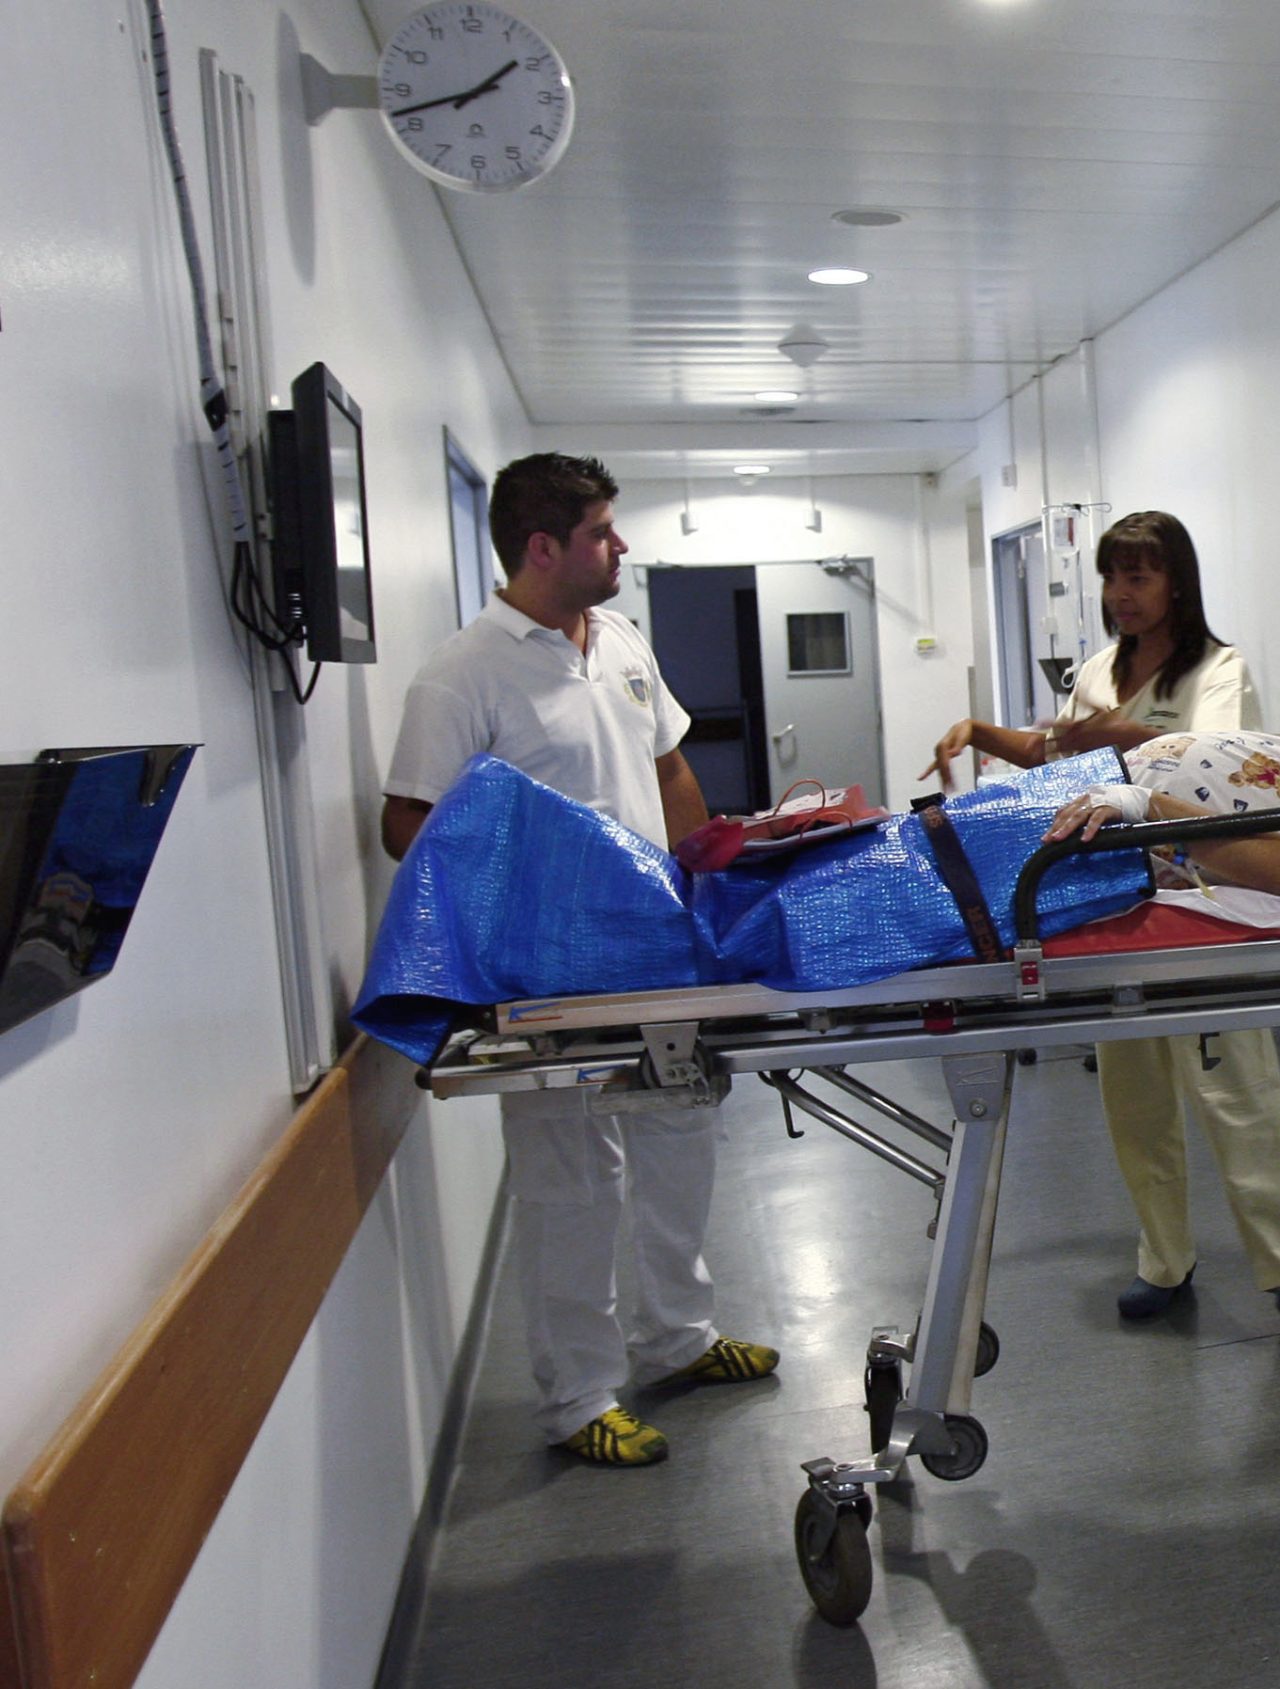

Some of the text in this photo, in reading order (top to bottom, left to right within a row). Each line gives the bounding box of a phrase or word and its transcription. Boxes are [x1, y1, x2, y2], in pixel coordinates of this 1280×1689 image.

[460, 18, 483, 34] 12
[428, 27, 443, 41] 11
[502, 31, 511, 42] 1
[405, 50, 427, 65] 10
[526, 57, 540, 72] 2
[395, 83, 411, 97] 9
[538, 91, 551, 105] 3
[408, 117, 423, 132] 8
[529, 124, 543, 136] 4
[435, 143, 451, 157] 7
[506, 146, 521, 160] 5
[470, 155, 486, 169] 6
